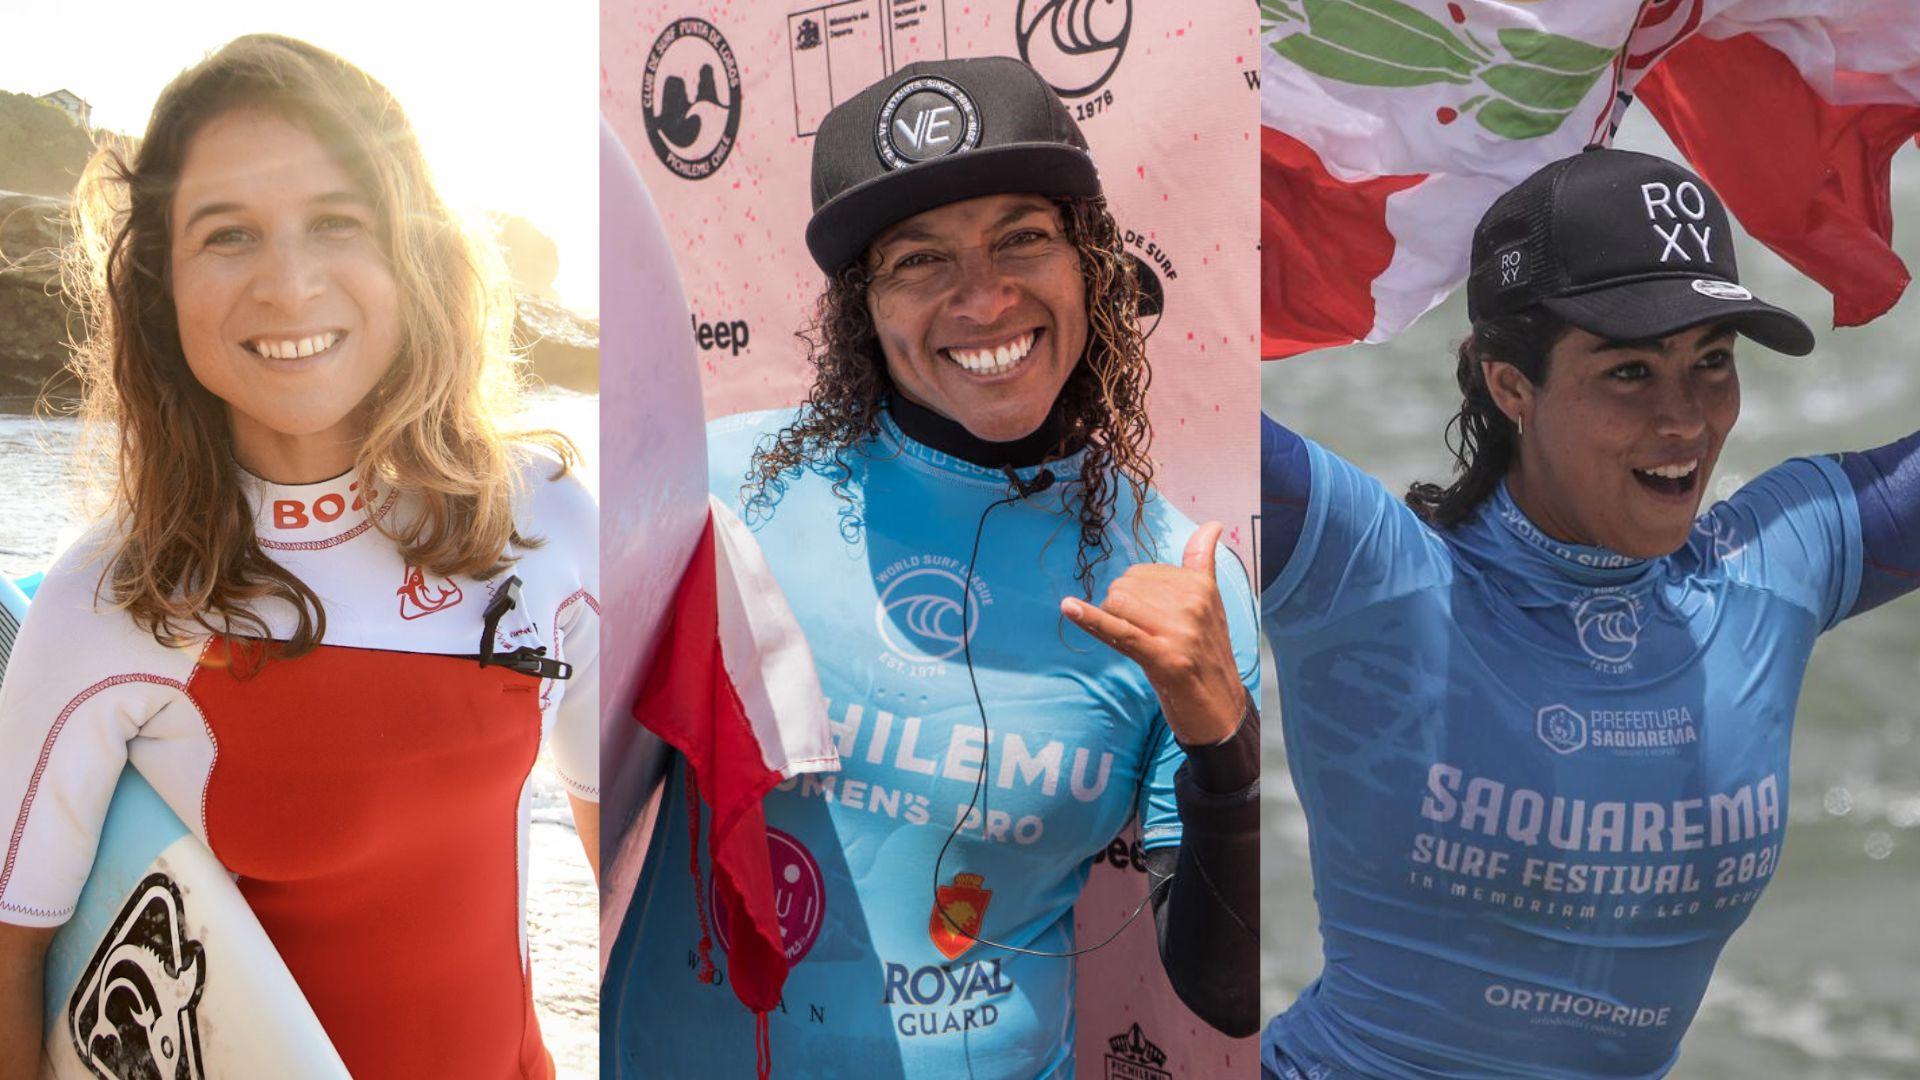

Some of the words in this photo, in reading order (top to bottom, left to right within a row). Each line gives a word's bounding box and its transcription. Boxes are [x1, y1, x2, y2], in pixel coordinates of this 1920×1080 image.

[1076, 89, 1114, 121] 1976
[1641, 181, 1706, 222] RO
[1124, 229, 1145, 249] DE
[1145, 242, 1178, 281] SURF
[1653, 223, 1712, 264] XY
[1501, 265, 1520, 286] XY
[876, 556, 920, 583] WORLD
[923, 554, 959, 569] SURF
[1591, 706, 1694, 730] PREFEITURA
[1592, 725, 1697, 748] SAQUAREMA
[824, 698, 1114, 803] HILEMU
[775, 772, 931, 826] MEN'S
[954, 803, 1044, 846] PRO
[1421, 763, 1780, 853] SAQUAREMA
[1412, 833, 1510, 881] SURF
[1522, 857, 1700, 895] FESTIVAL
[1410, 871, 1433, 888] IN
[1451, 883, 1596, 919] MEMORIAM
[1613, 905, 1641, 919] OF
[1657, 901, 1700, 918] LEO
[882, 957, 1014, 1006] ROYAL
[898, 1003, 999, 1037] GUARD
[1484, 984, 1672, 1028] ORTHOPRIDE
